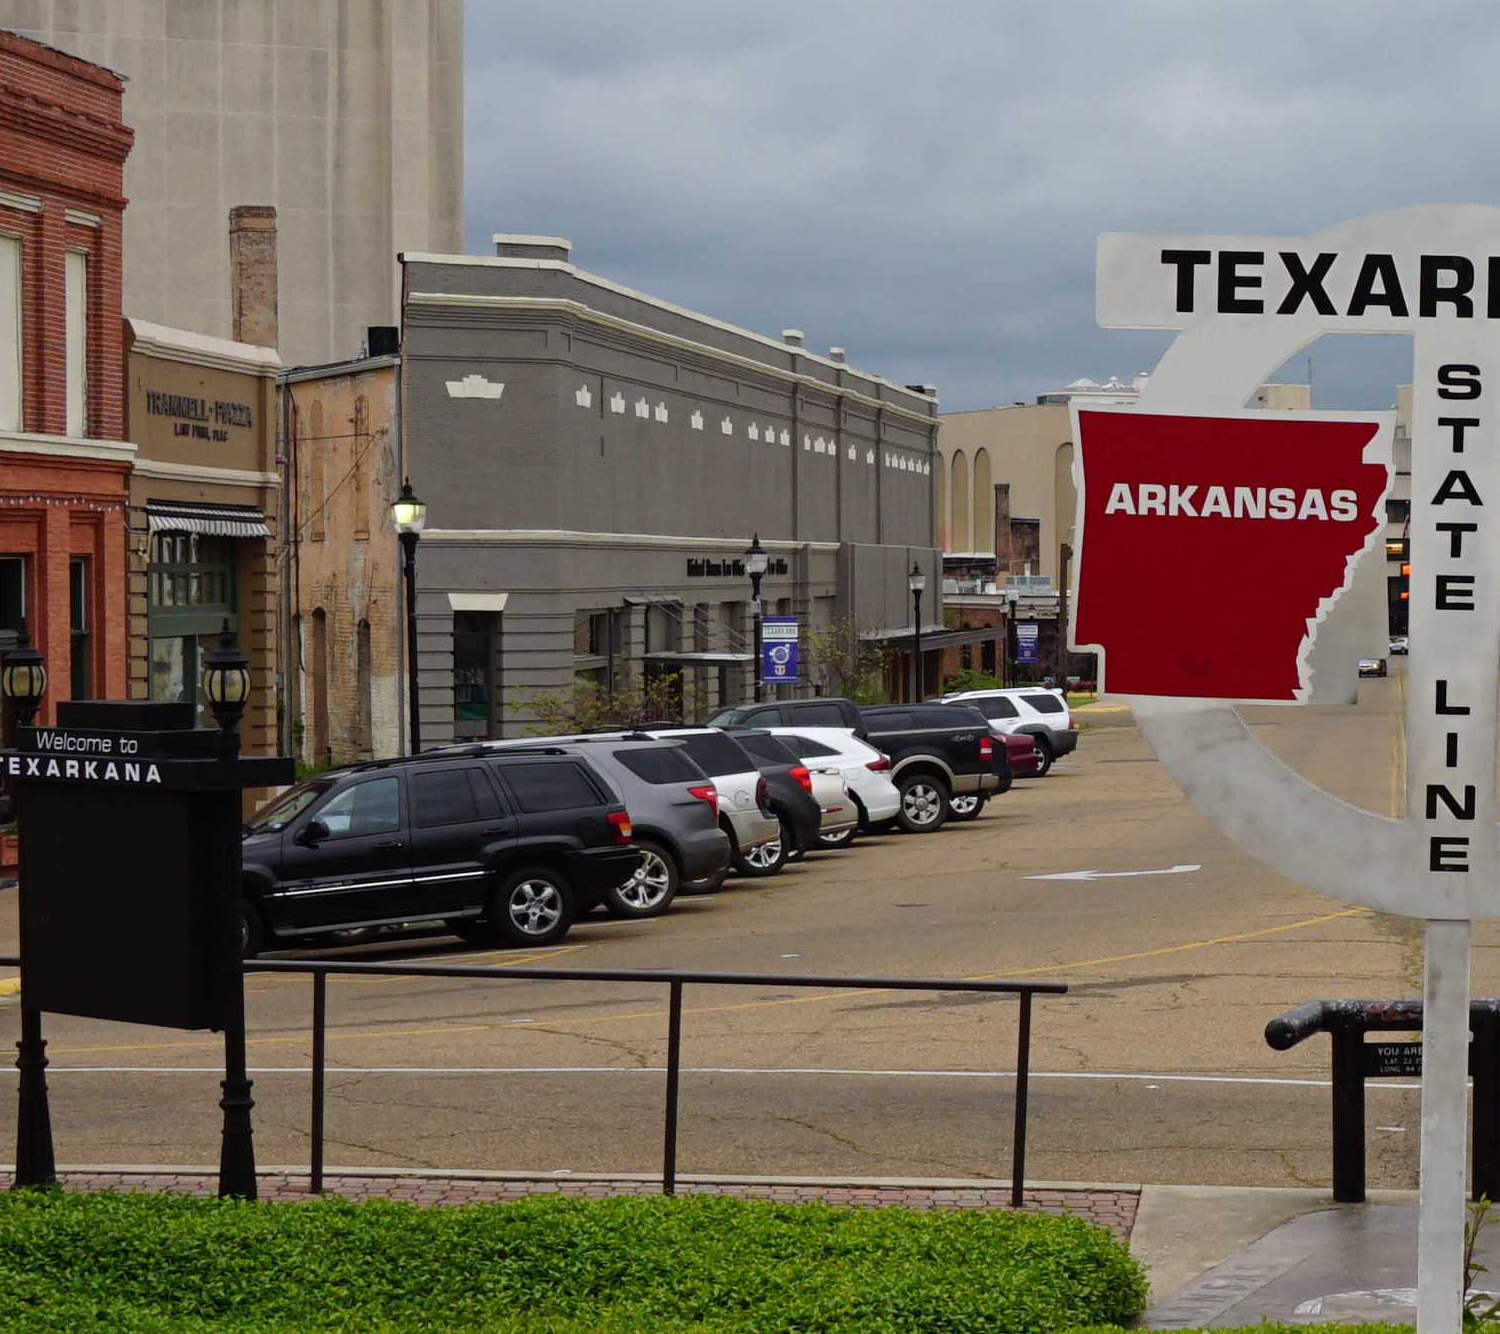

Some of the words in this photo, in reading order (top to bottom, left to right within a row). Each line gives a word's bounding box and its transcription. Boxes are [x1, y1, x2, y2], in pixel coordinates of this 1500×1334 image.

[146, 389, 209, 422] TRAMMELL
[1105, 483, 1358, 522] ARKANSAS
[1430, 364, 1484, 611] STATE
[36, 731, 112, 753] Welcome
[119, 737, 138, 754] to
[1426, 680, 1476, 872] LINE
[1377, 1047, 1400, 1056] YOU
[1403, 1047, 1423, 1056] ARE
